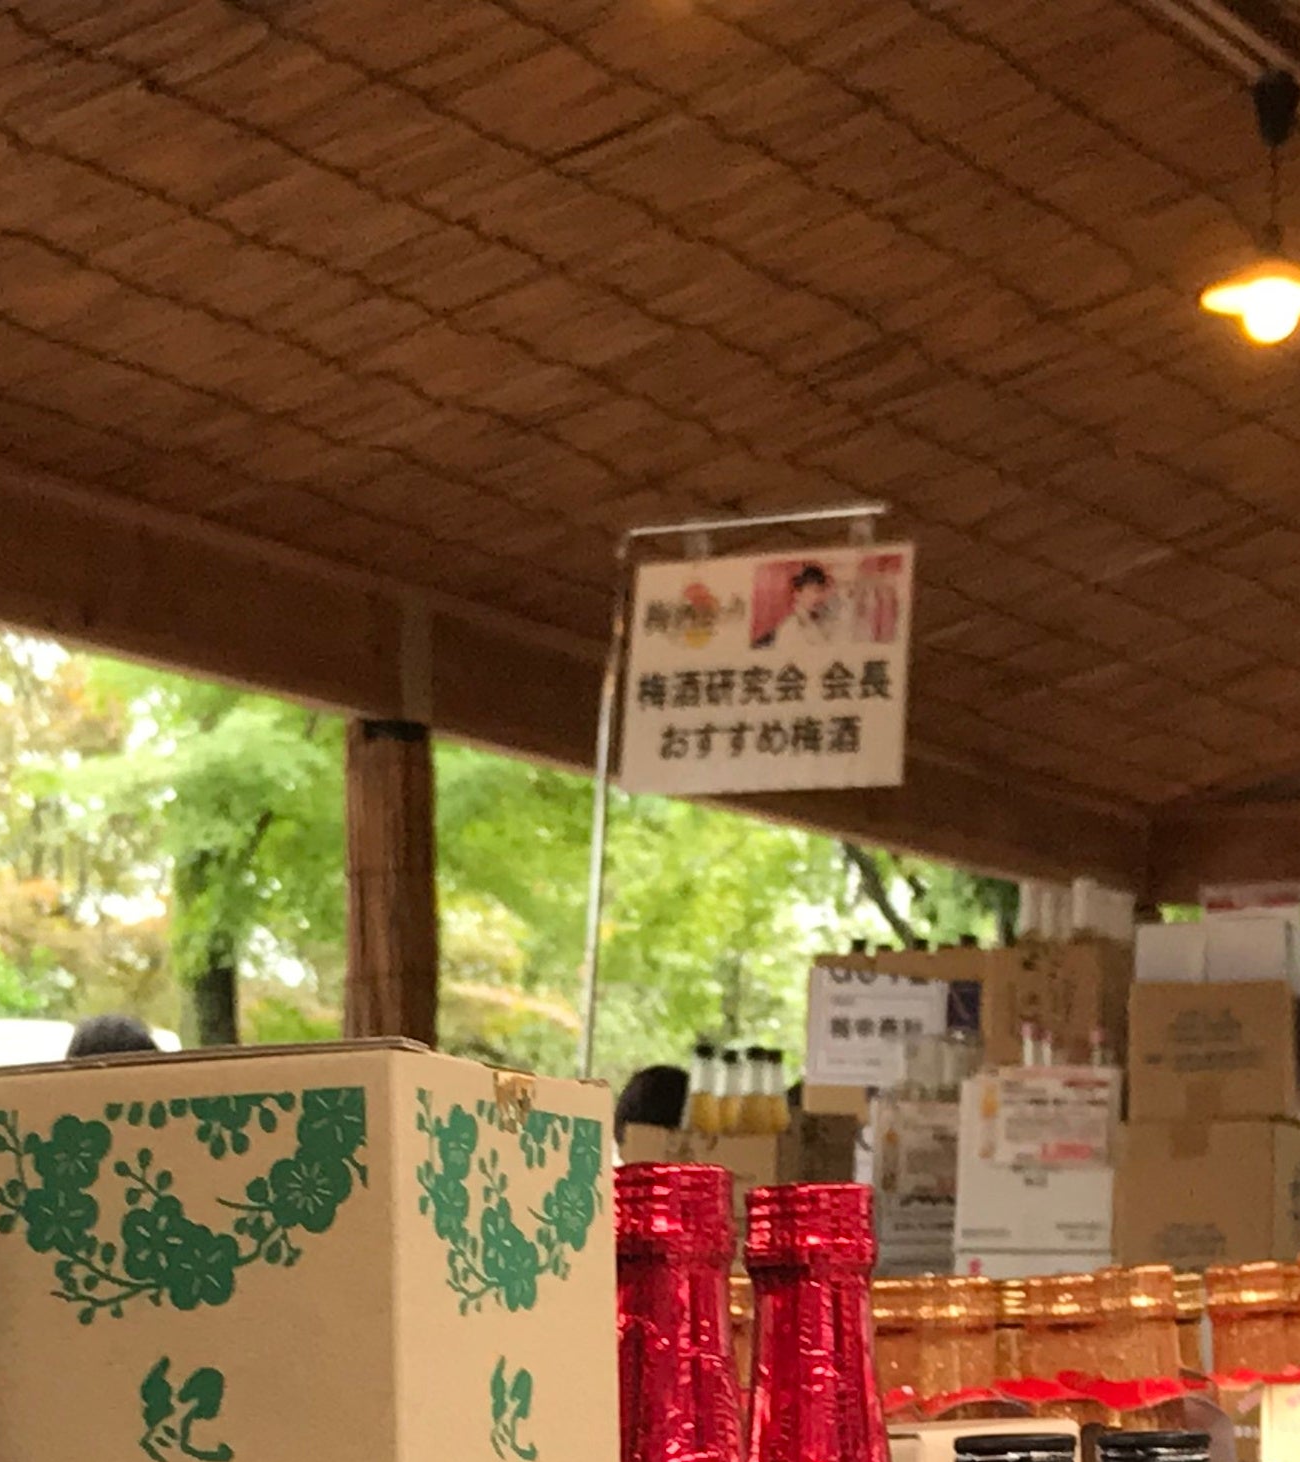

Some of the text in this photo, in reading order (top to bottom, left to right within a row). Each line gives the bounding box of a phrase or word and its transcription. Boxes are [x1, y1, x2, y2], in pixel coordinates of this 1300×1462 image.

[638, 659, 890, 709] 梅酒研究会 会長
[660, 715, 861, 759] おすすめ梅酒
